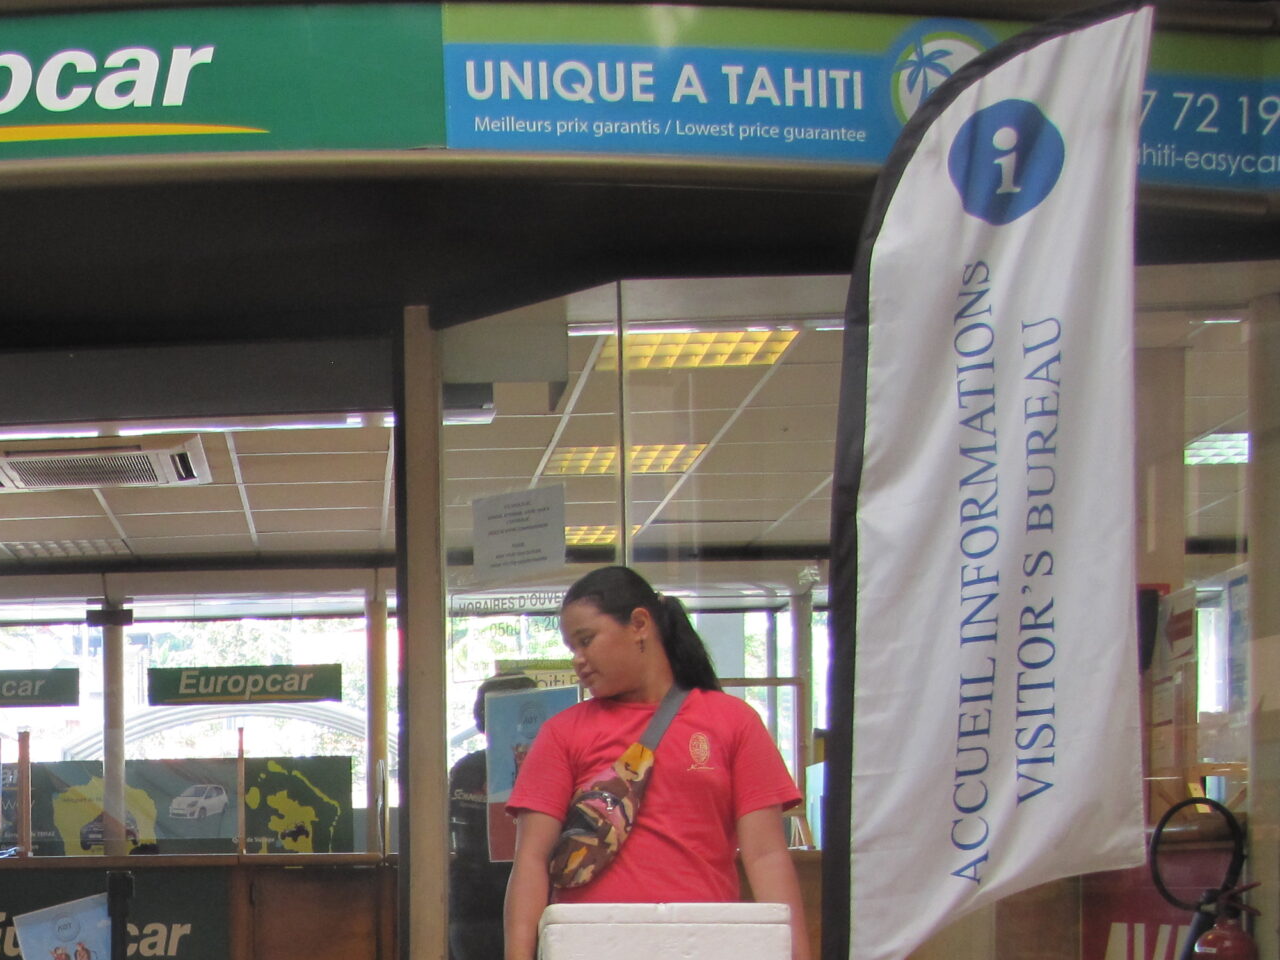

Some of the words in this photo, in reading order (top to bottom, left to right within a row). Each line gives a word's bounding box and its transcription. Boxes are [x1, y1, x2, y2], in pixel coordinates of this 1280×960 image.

[465, 60, 655, 104] UNIQUE
[671, 64, 708, 104] A
[721, 65, 863, 110] TAHITI
[474, 116, 552, 133] Meilleurs
[556, 117, 589, 138] prix
[592, 118, 661, 137] garantis
[663, 119, 672, 136] /
[675, 120, 735, 137] Lowest
[738, 121, 780, 141] price
[783, 125, 867, 142] guarantee
[1173, 92, 1219, 133] 72
[1238, 95, 1280, 136] 19
[1020, 316, 1062, 534] BUREAU
[953, 259, 1000, 649] INFORMATIONS
[518, 592, 567, 609] D'OUVE
[178, 668, 314, 701] Europcar
[1015, 549, 1057, 808] VISITOR'S
[950, 656, 997, 885] ACCUEIL
